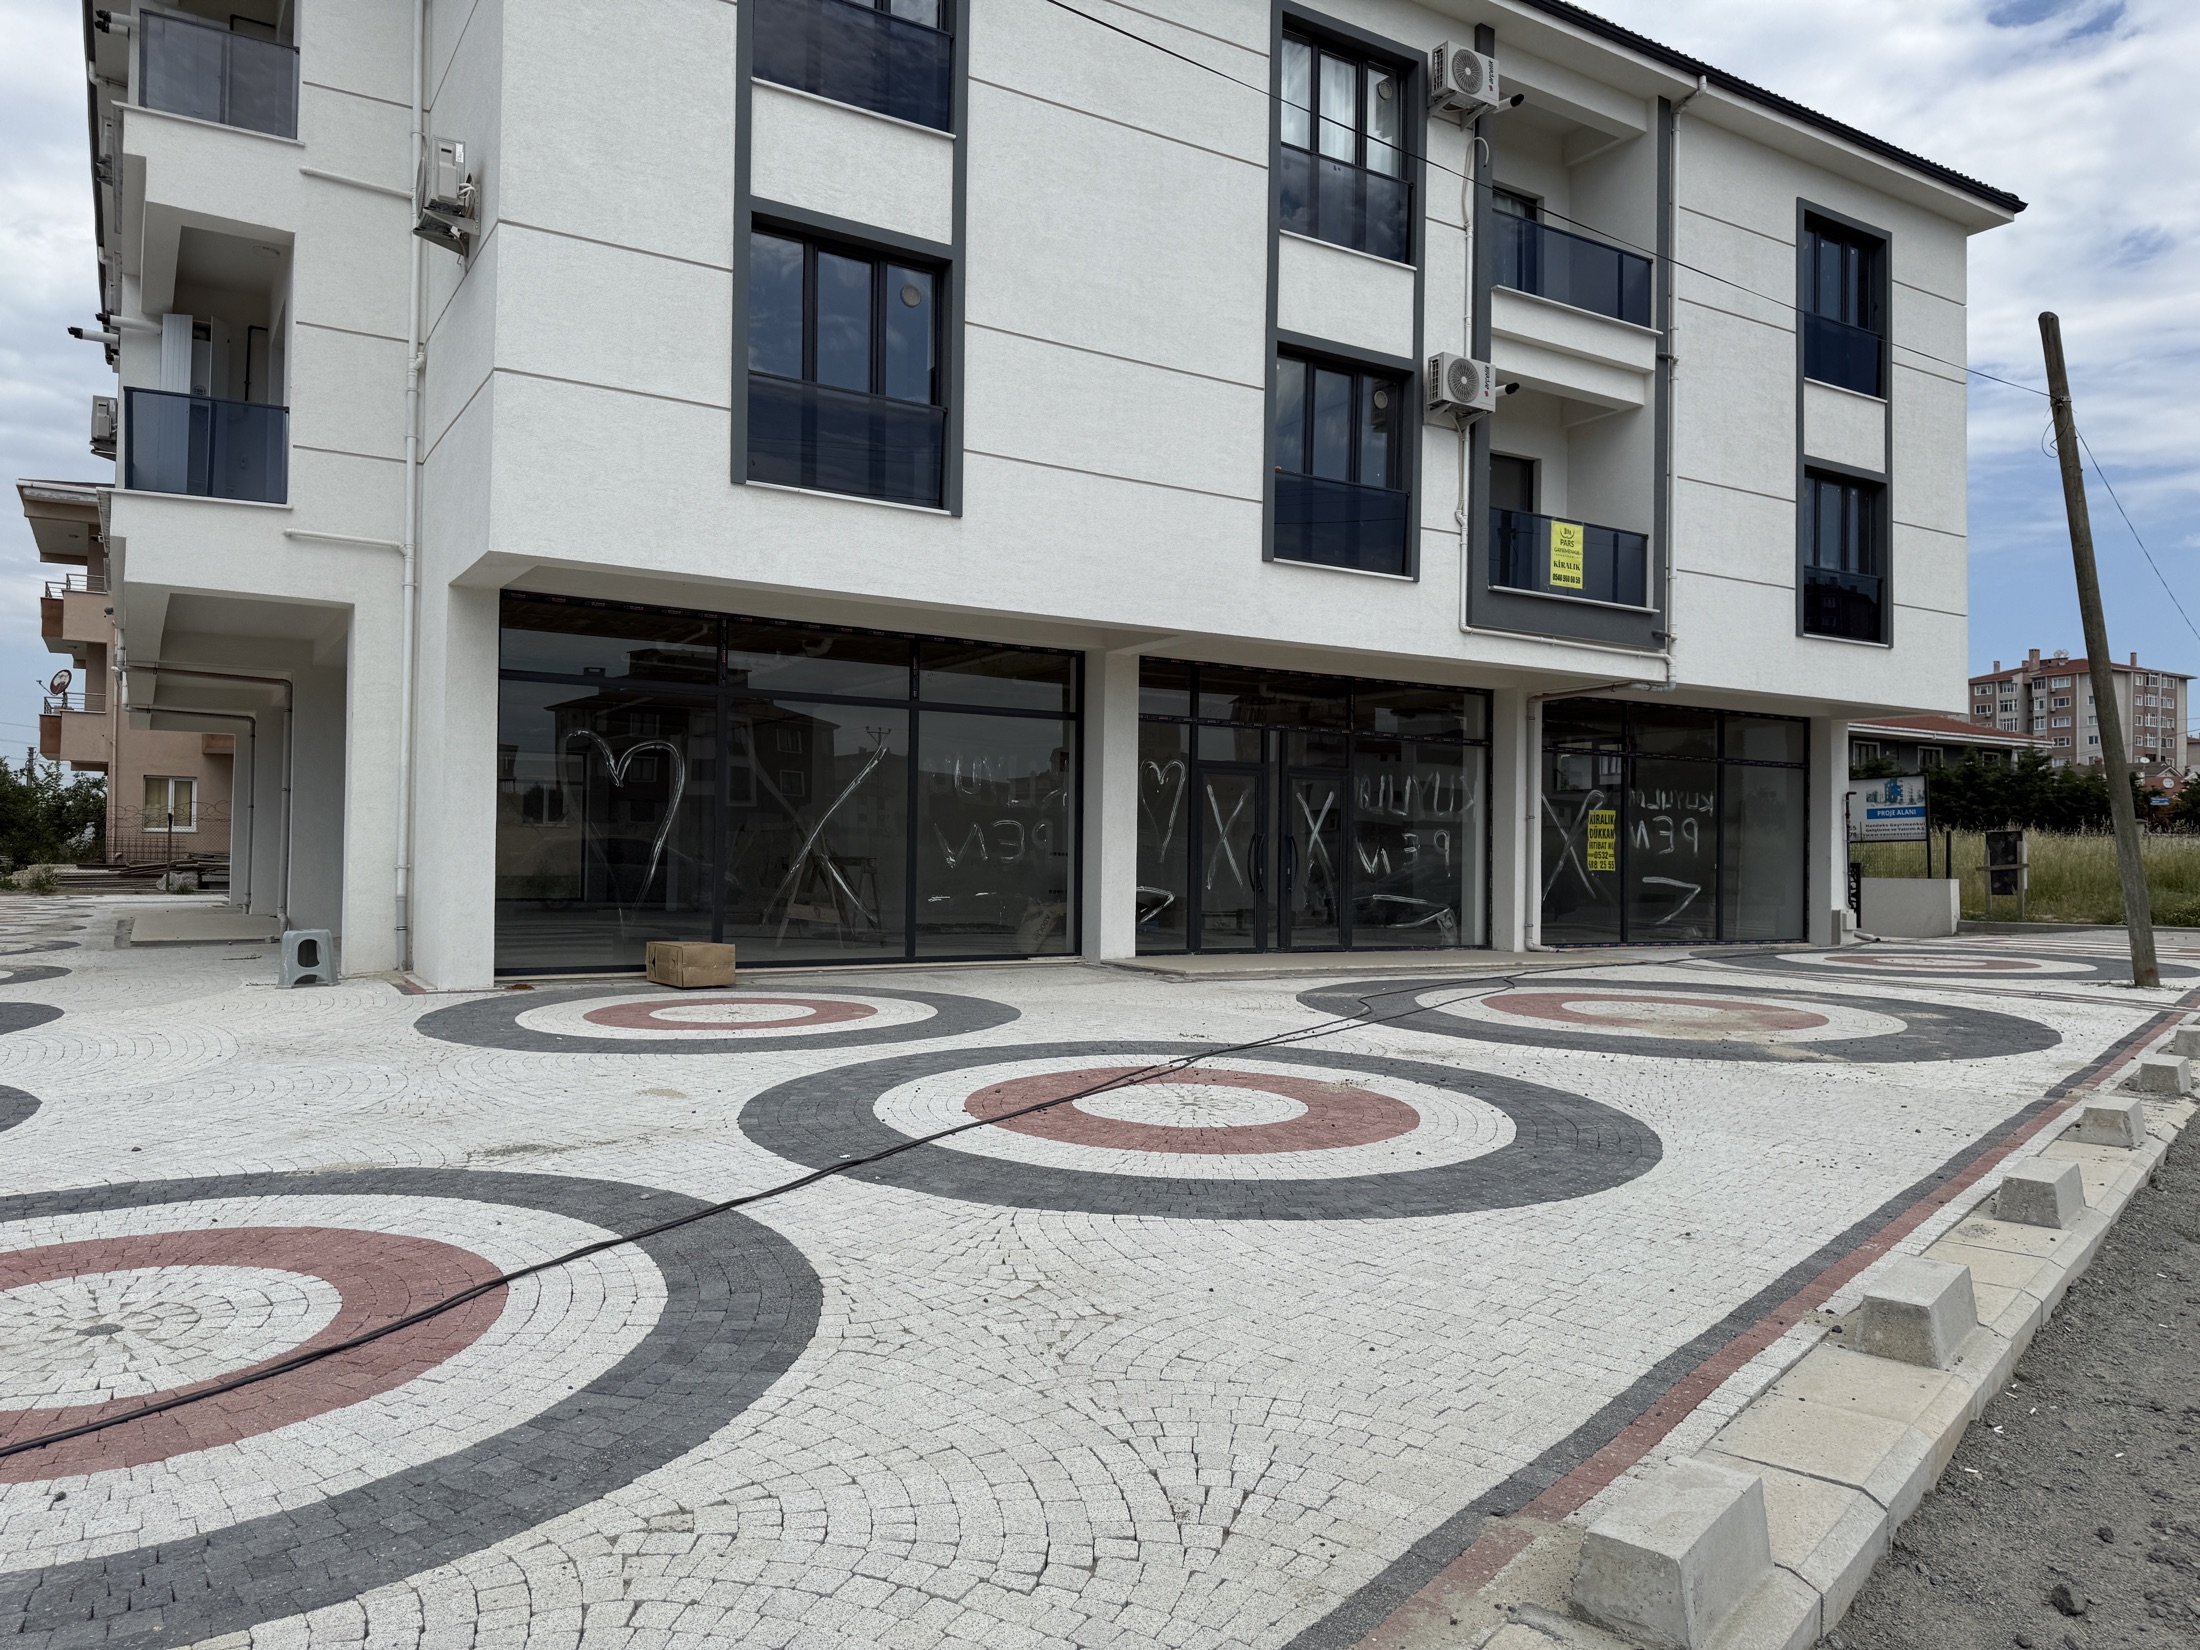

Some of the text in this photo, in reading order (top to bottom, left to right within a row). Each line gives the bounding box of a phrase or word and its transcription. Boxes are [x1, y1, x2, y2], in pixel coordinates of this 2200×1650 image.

[1560, 538, 1575, 547] PARS
[1553, 560, 1580, 570] KİRALIK
[1589, 811, 1615, 825] KİRALIK
[1589, 825, 1615, 839] DÜKKAN
